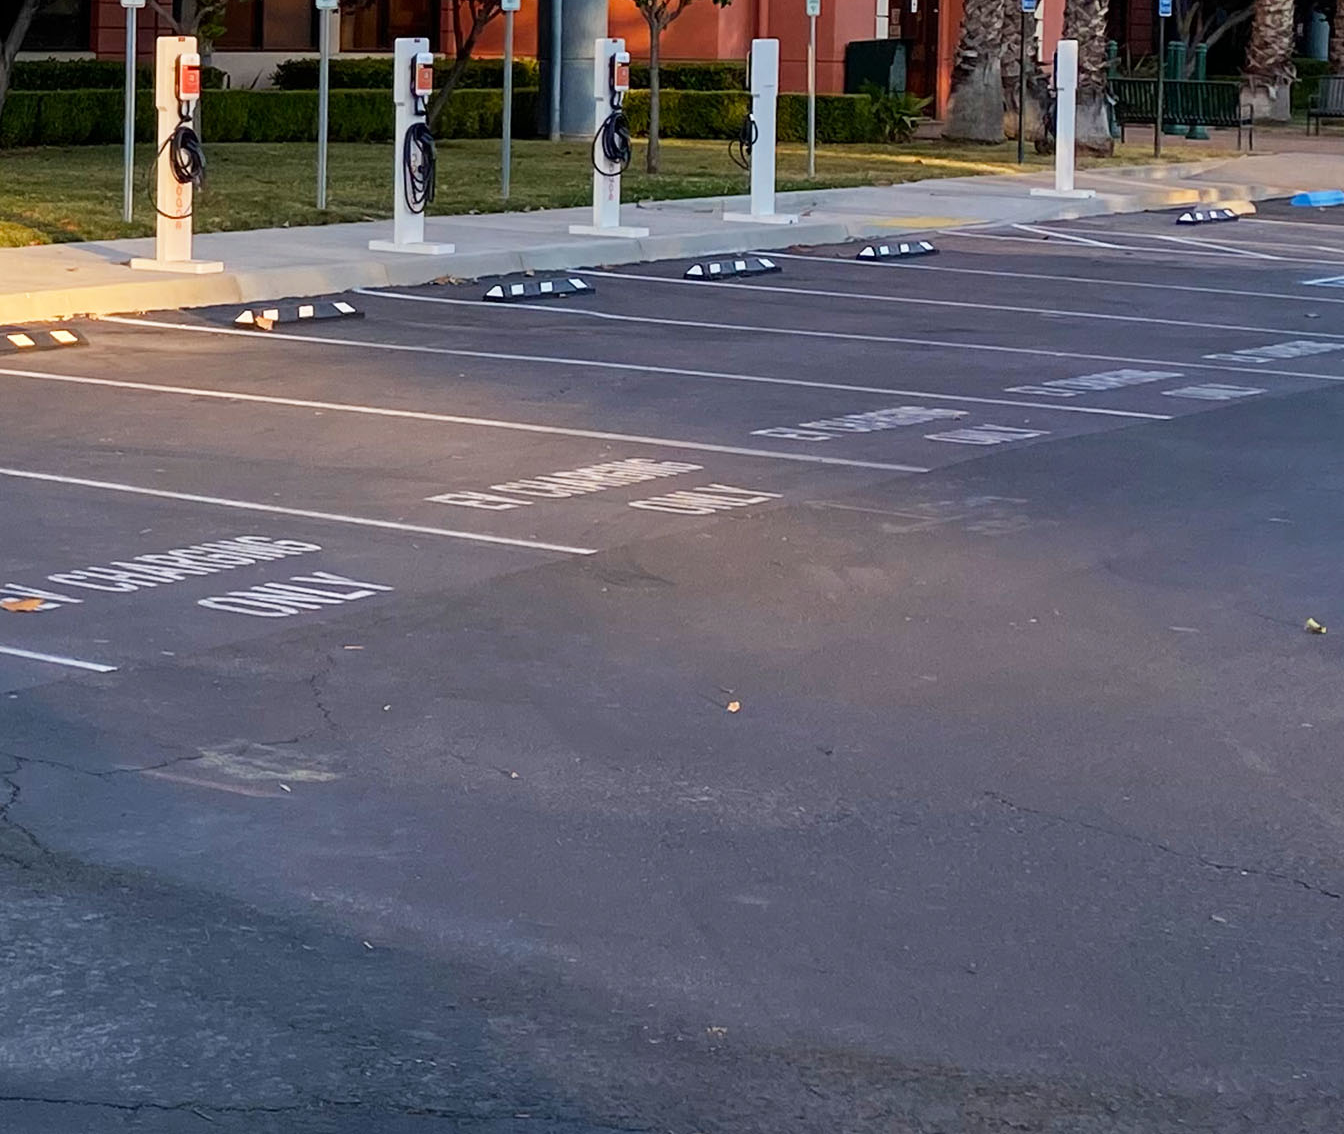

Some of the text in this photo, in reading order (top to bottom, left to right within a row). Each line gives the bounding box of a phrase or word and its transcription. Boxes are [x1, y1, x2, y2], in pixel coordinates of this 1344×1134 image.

[423, 458, 704, 511] EV CHARGING
[628, 484, 784, 514] ONLY
[47, 535, 322, 592] CHARGING
[197, 571, 395, 617] ONLY
